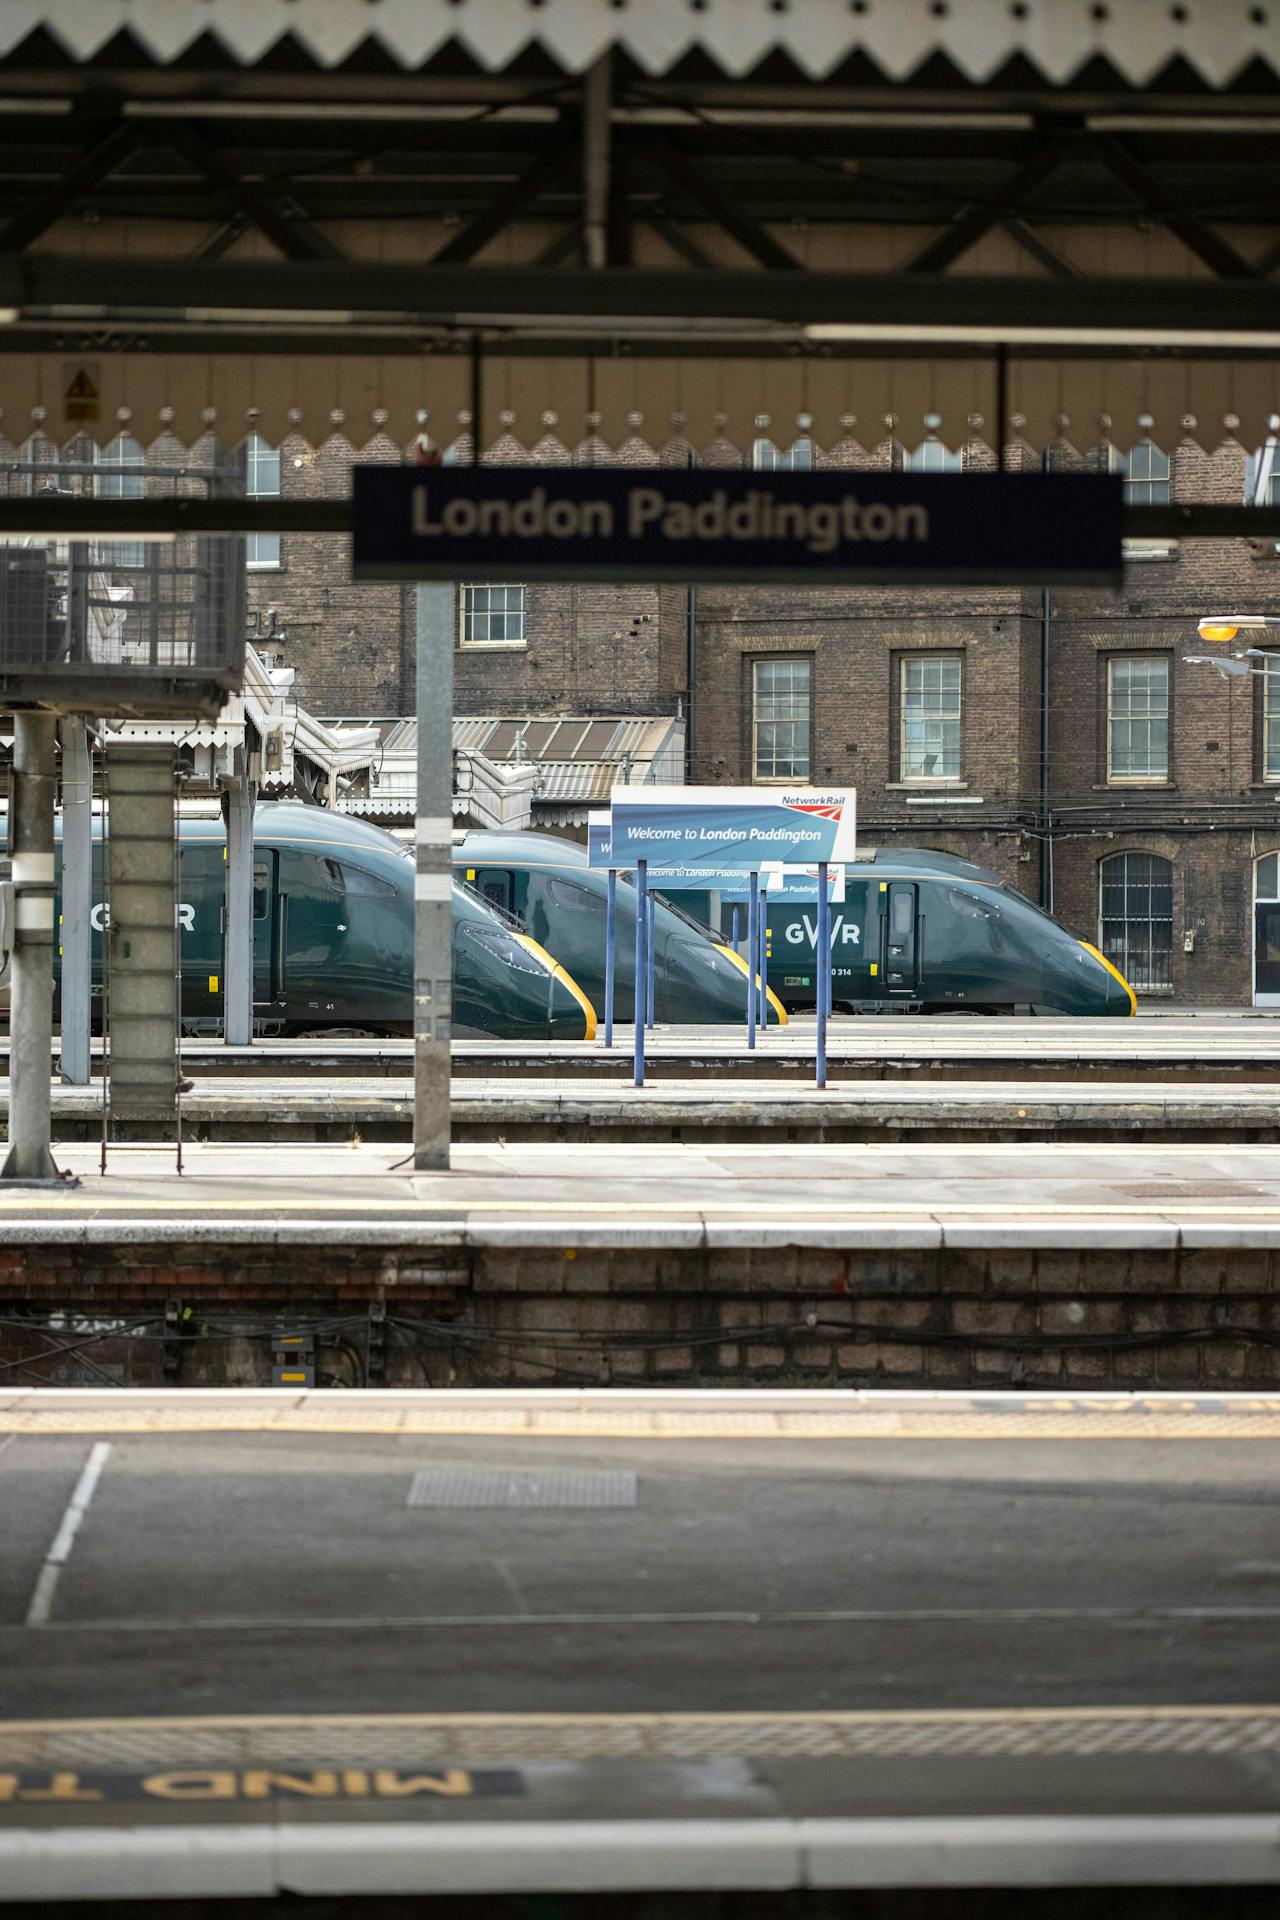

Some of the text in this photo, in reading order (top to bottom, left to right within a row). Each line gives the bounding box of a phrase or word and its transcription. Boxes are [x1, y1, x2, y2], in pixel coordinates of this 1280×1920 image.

[411, 485, 930, 552] London Paddington
[627, 827, 822, 844] Welcome to London Paddington
[645, 868, 675, 877] elcome
[91, 903, 196, 931] GR
[785, 914, 860, 950] GWR
[838, 968, 852, 976] 314
[142, 1769, 472, 1799] MIND
